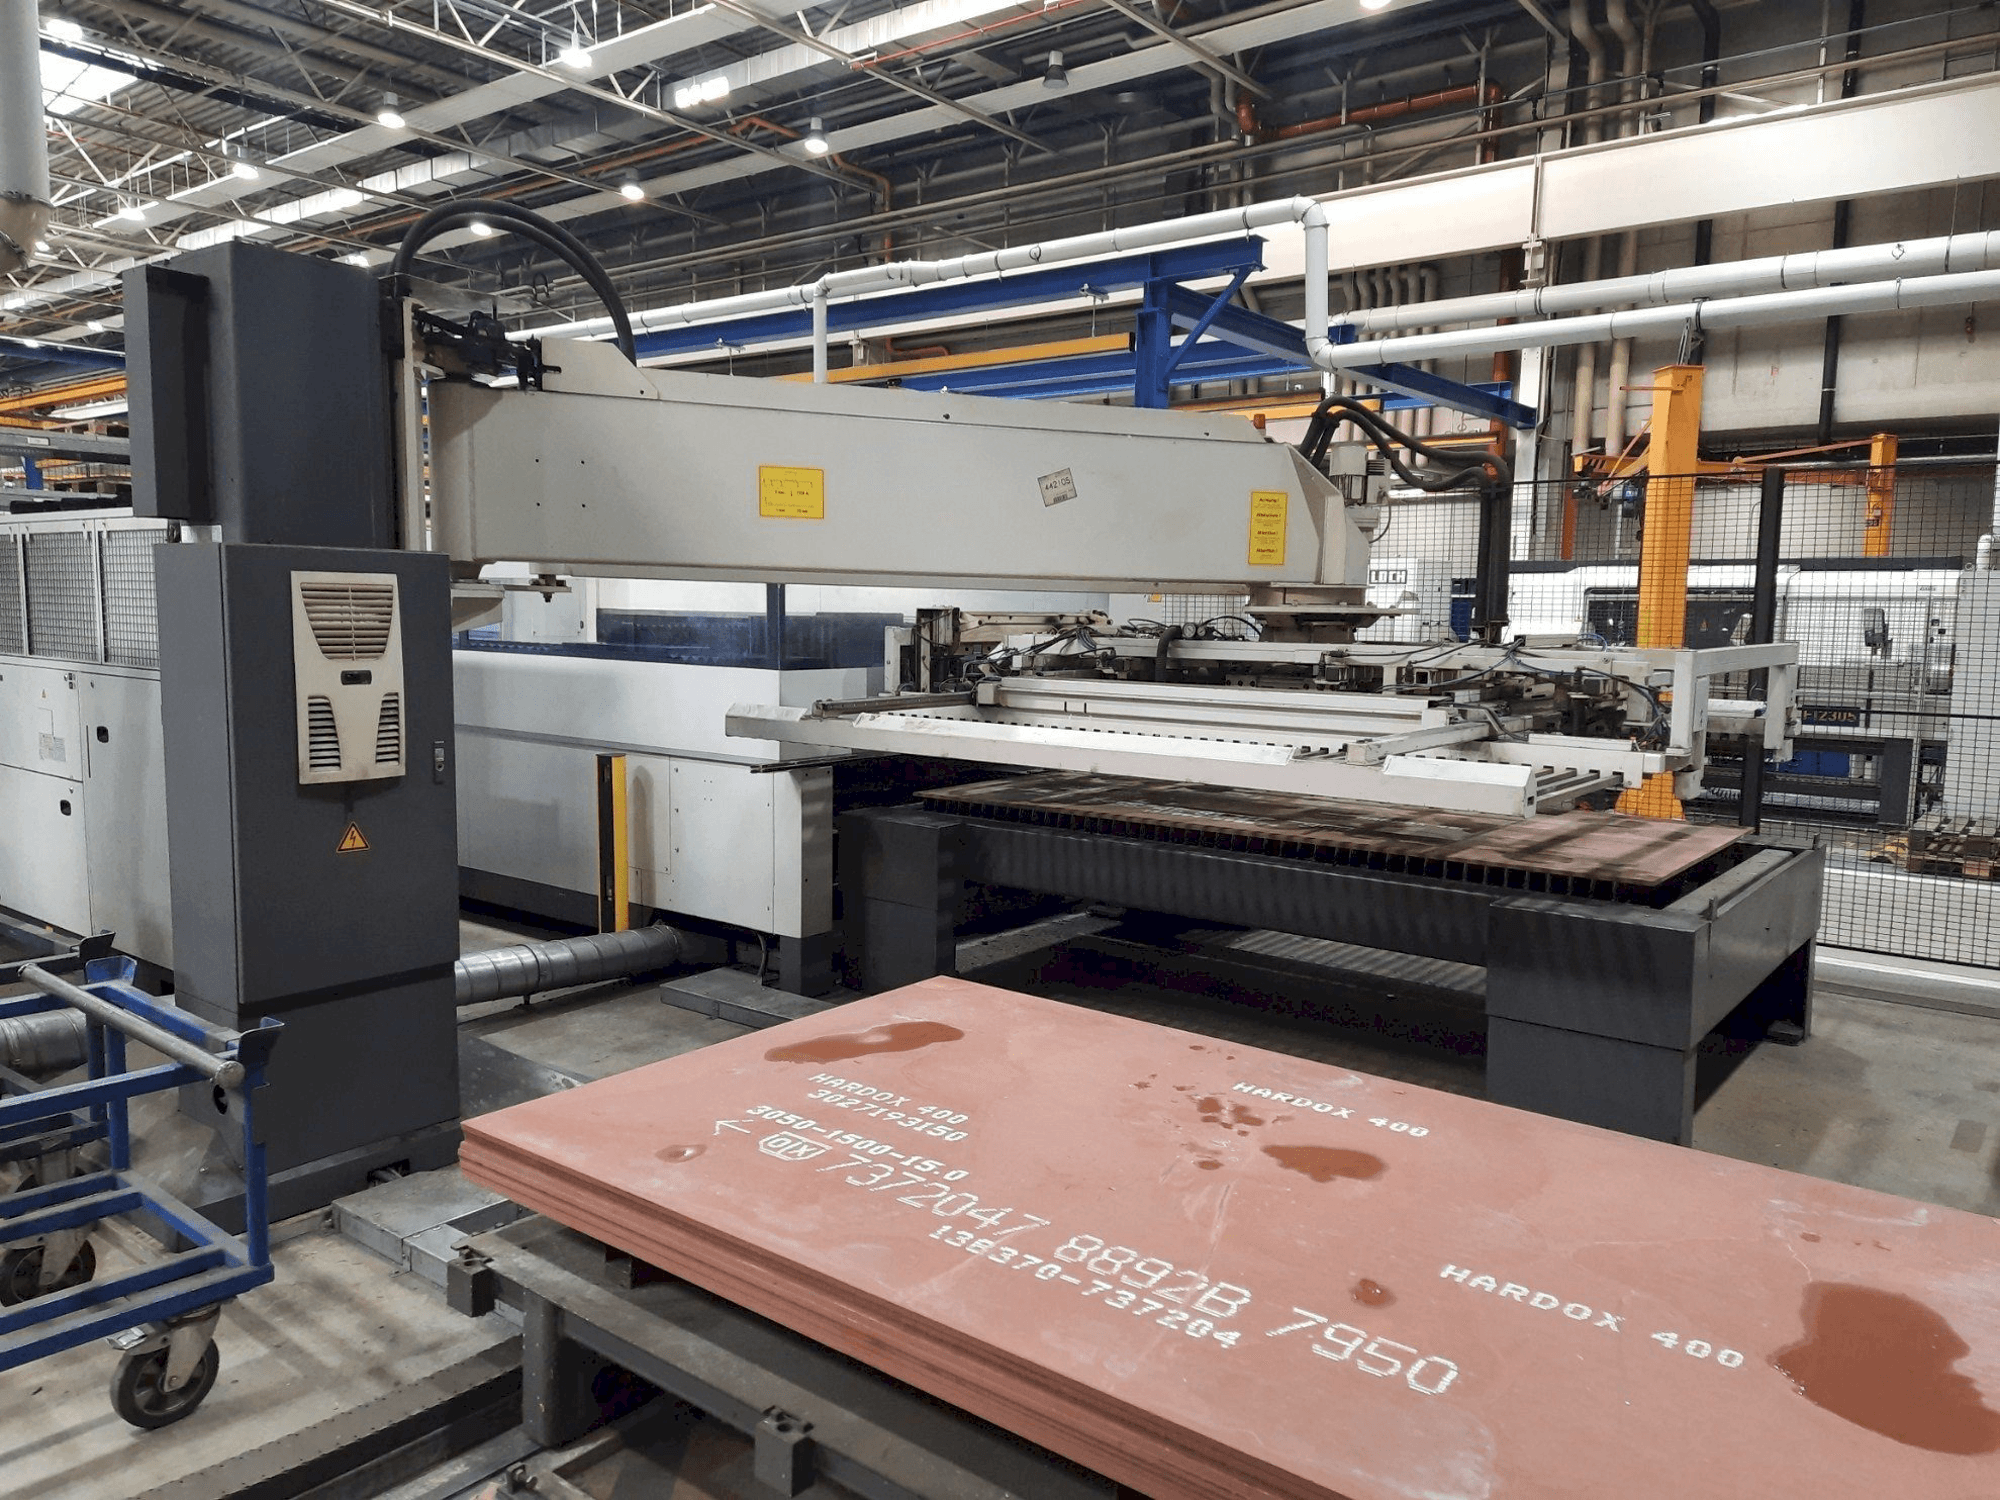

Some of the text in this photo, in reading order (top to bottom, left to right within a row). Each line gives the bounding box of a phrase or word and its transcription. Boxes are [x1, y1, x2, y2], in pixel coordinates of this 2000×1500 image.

[807, 1089, 969, 1141] 3027193150
[808, 1073, 969, 1124] HARDOX 400
[1232, 1082, 1430, 1137] HARDOX 400
[746, 1105, 970, 1181] 3050-1500-15.0
[815, 1153, 1460, 1396] 7372047 8892B 7950
[1440, 1264, 1744, 1368] HARDOX 400
